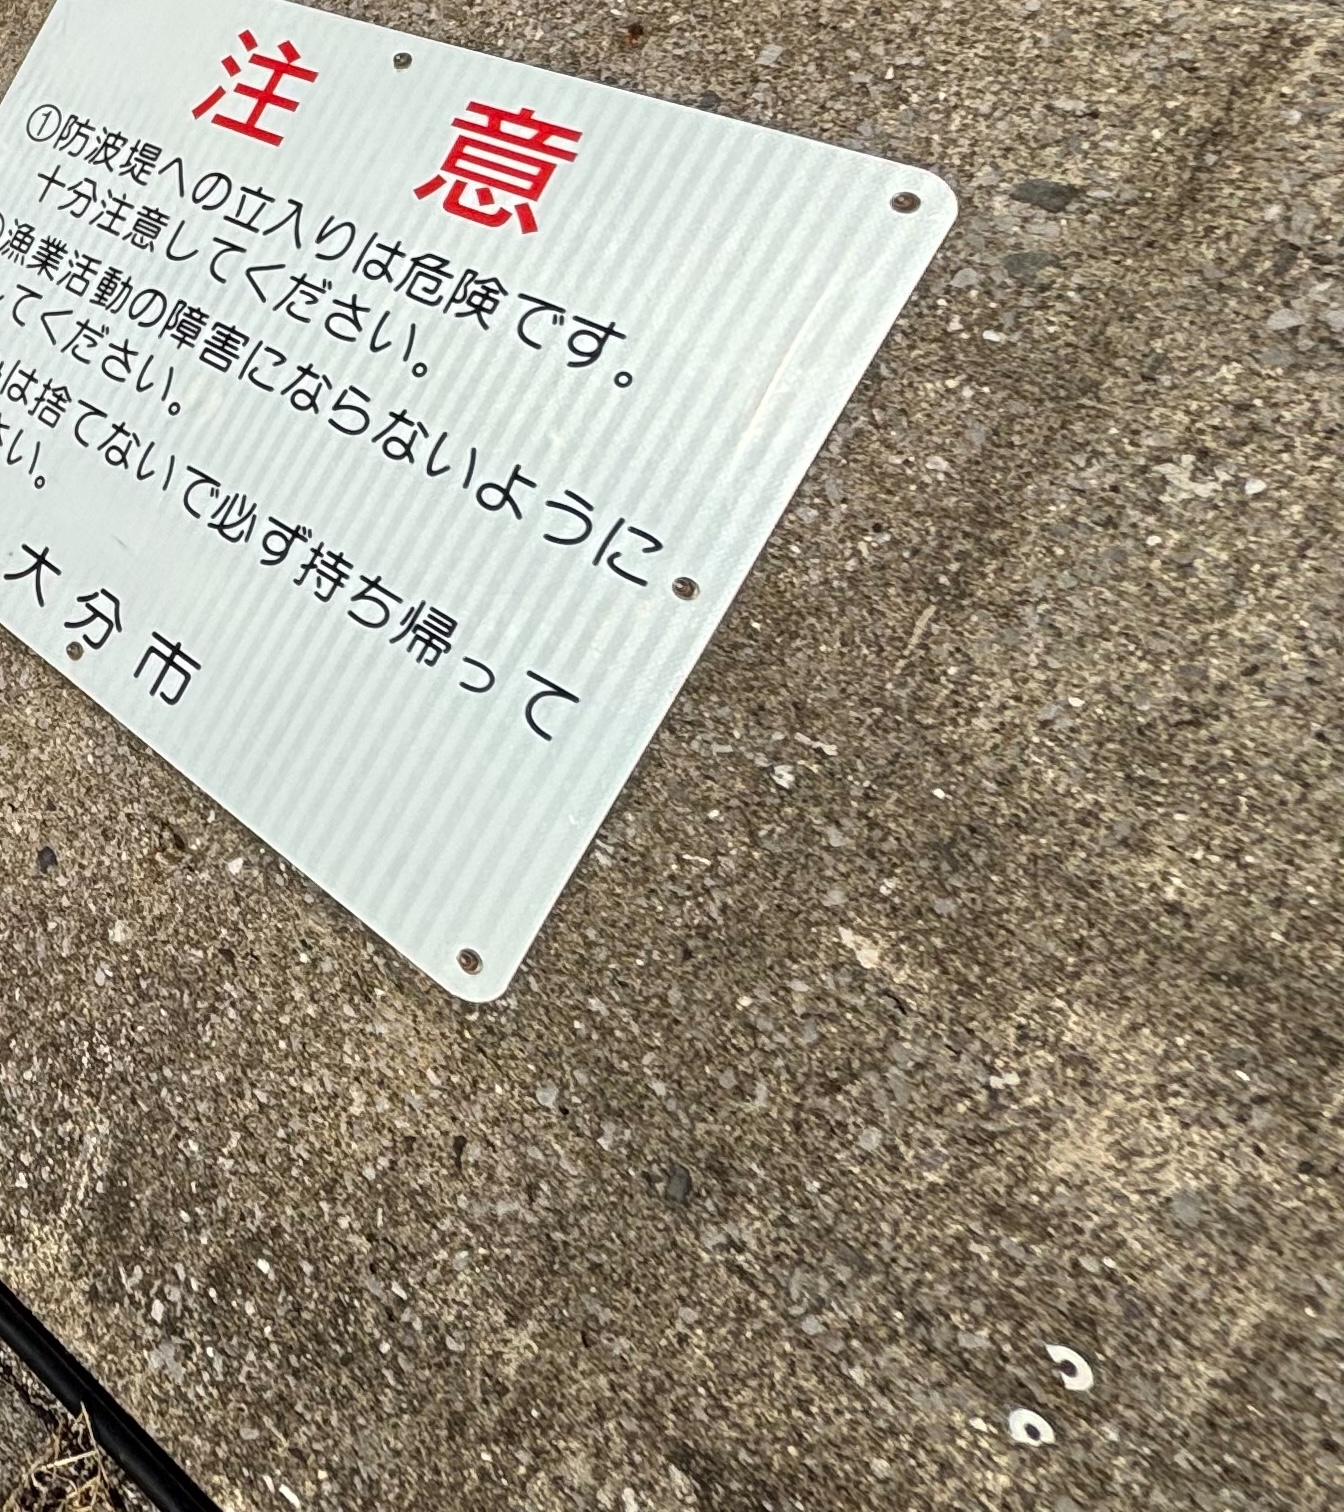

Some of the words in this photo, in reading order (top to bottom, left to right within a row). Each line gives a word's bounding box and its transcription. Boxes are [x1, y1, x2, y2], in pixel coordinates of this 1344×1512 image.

[26, 104, 633, 388] ①防波堤への立入りは危険です。
[37, 164, 428, 378] 十分注意してください。
[3, 544, 202, 706] 大分市
